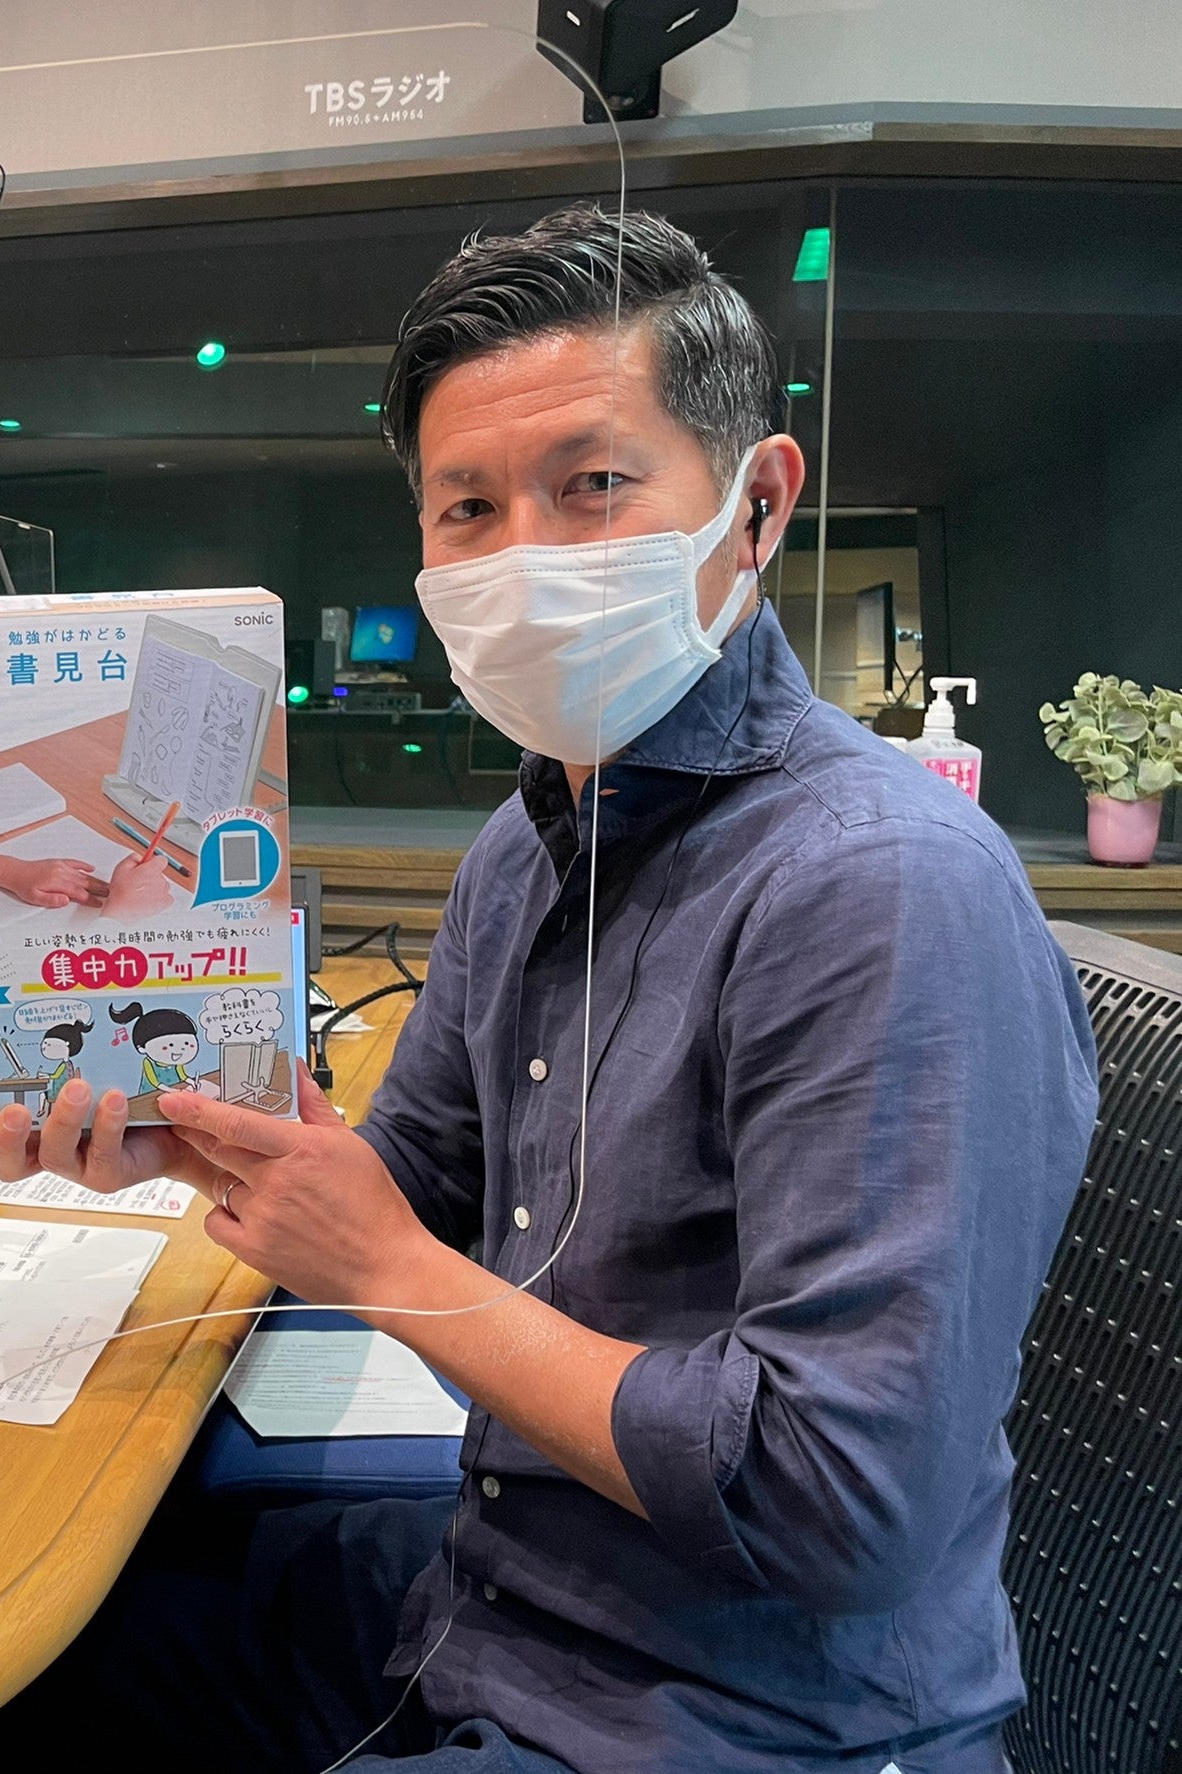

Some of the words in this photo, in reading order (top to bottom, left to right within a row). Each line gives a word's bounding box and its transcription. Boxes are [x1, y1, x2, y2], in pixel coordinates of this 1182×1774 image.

[304, 69, 451, 114] TBSラジオ
[8, 627, 128, 646] 勉強がはかどる
[6, 649, 129, 686] 書見台
[202, 807, 274, 831] タブレット学習に
[212, 901, 269, 912] プログラミング
[224, 911, 257, 920] 学習にも
[221, 1020, 265, 1038] らくらく
